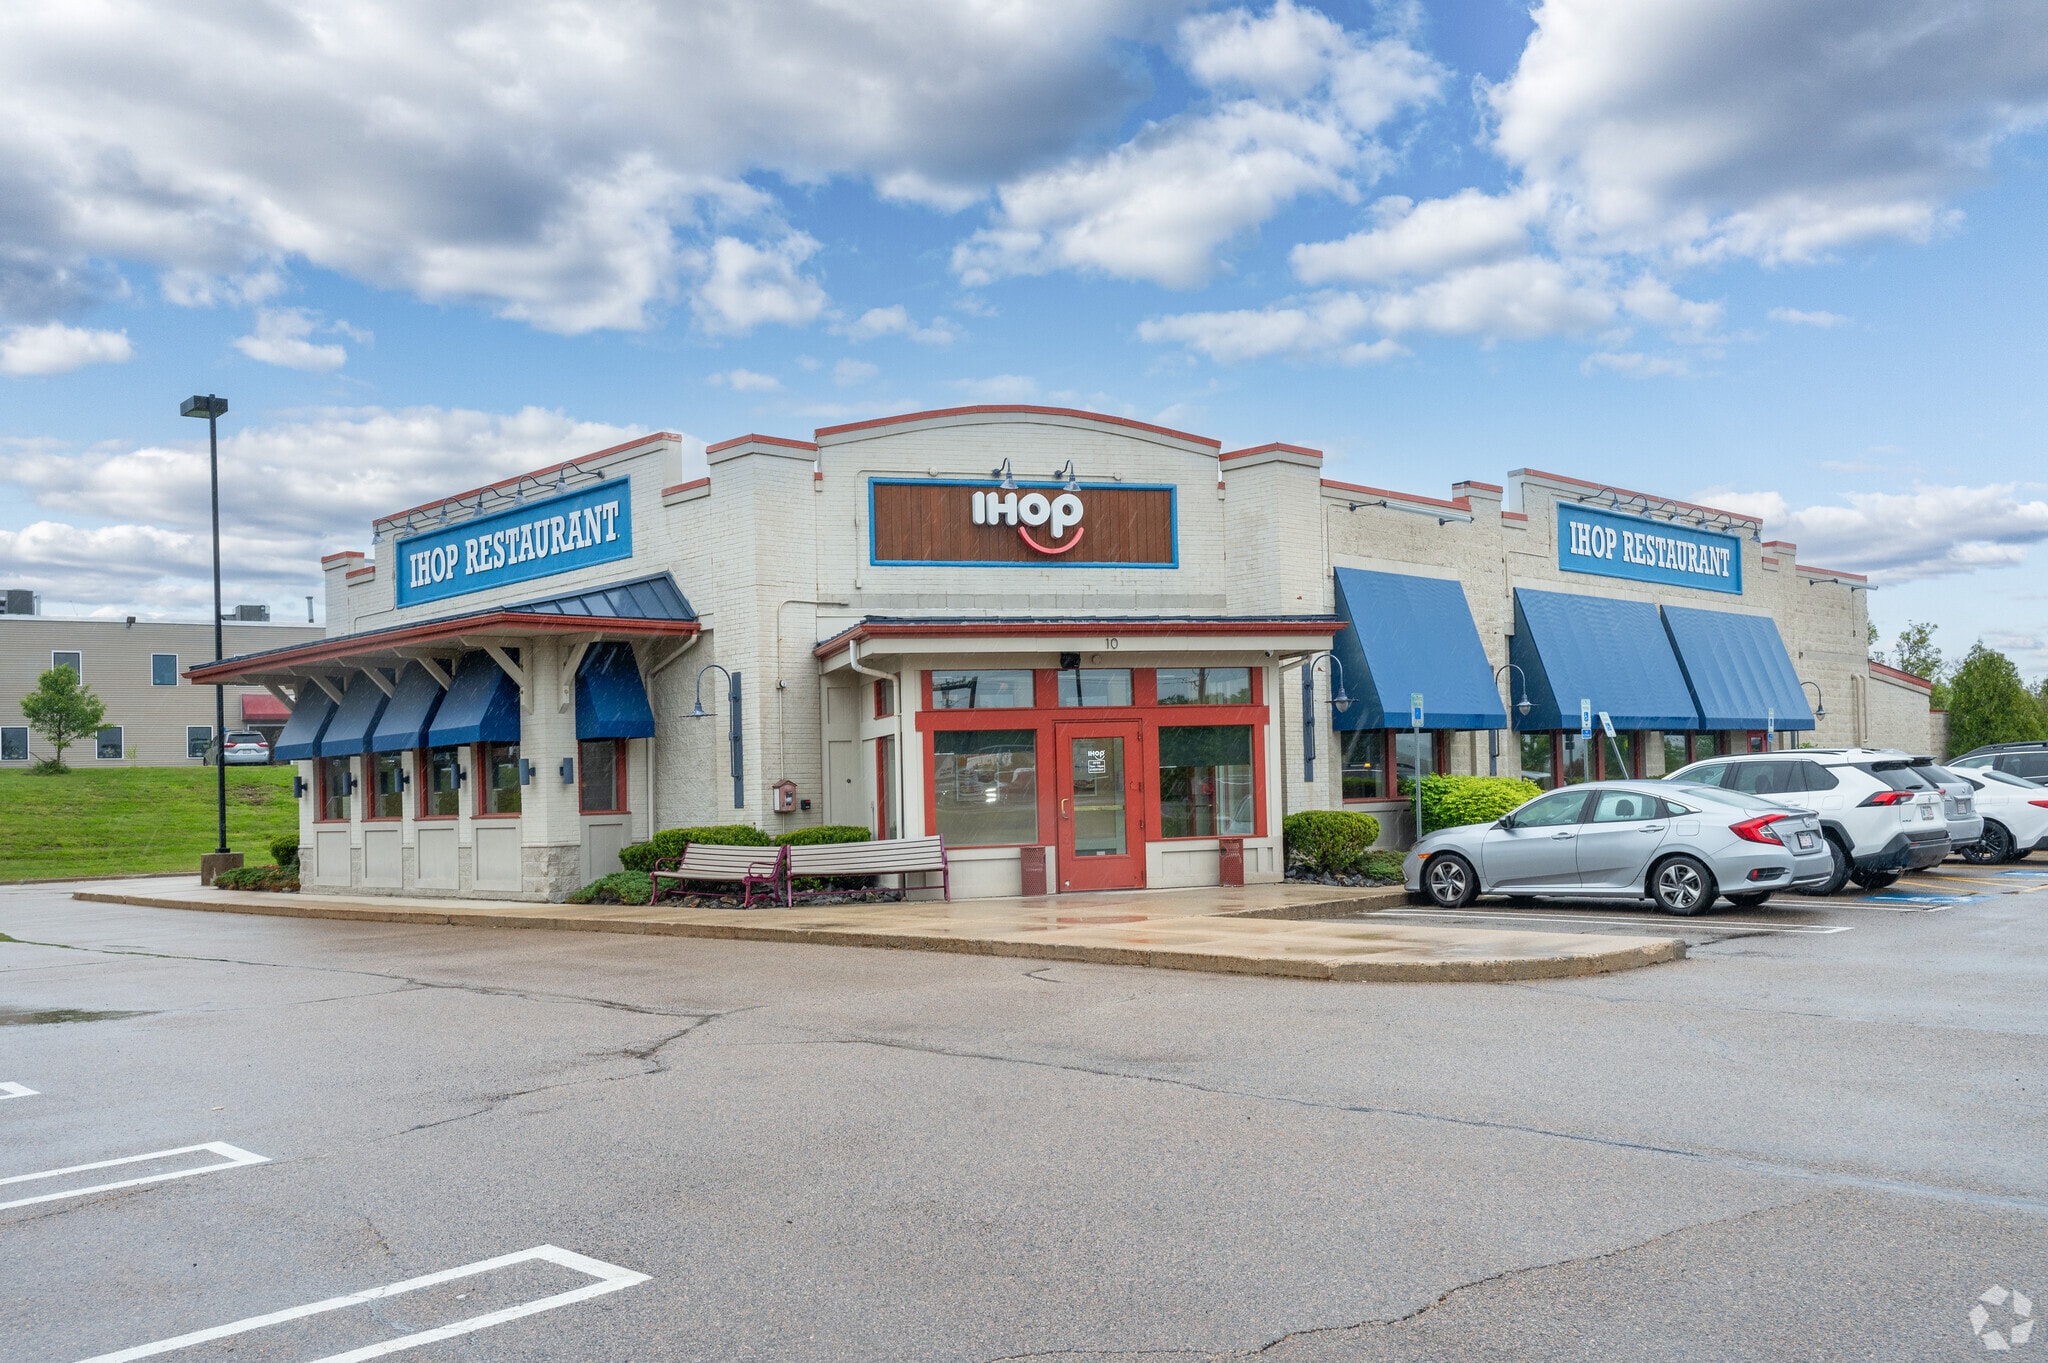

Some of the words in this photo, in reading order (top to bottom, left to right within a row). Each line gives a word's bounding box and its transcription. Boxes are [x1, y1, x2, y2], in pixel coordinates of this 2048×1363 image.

[409, 544, 459, 588] IHOP
[465, 500, 620, 575] RESTAURANT
[1569, 521, 1617, 560] IHOP
[1622, 530, 1730, 578] RESTAURANT
[1105, 637, 1119, 650] 10
